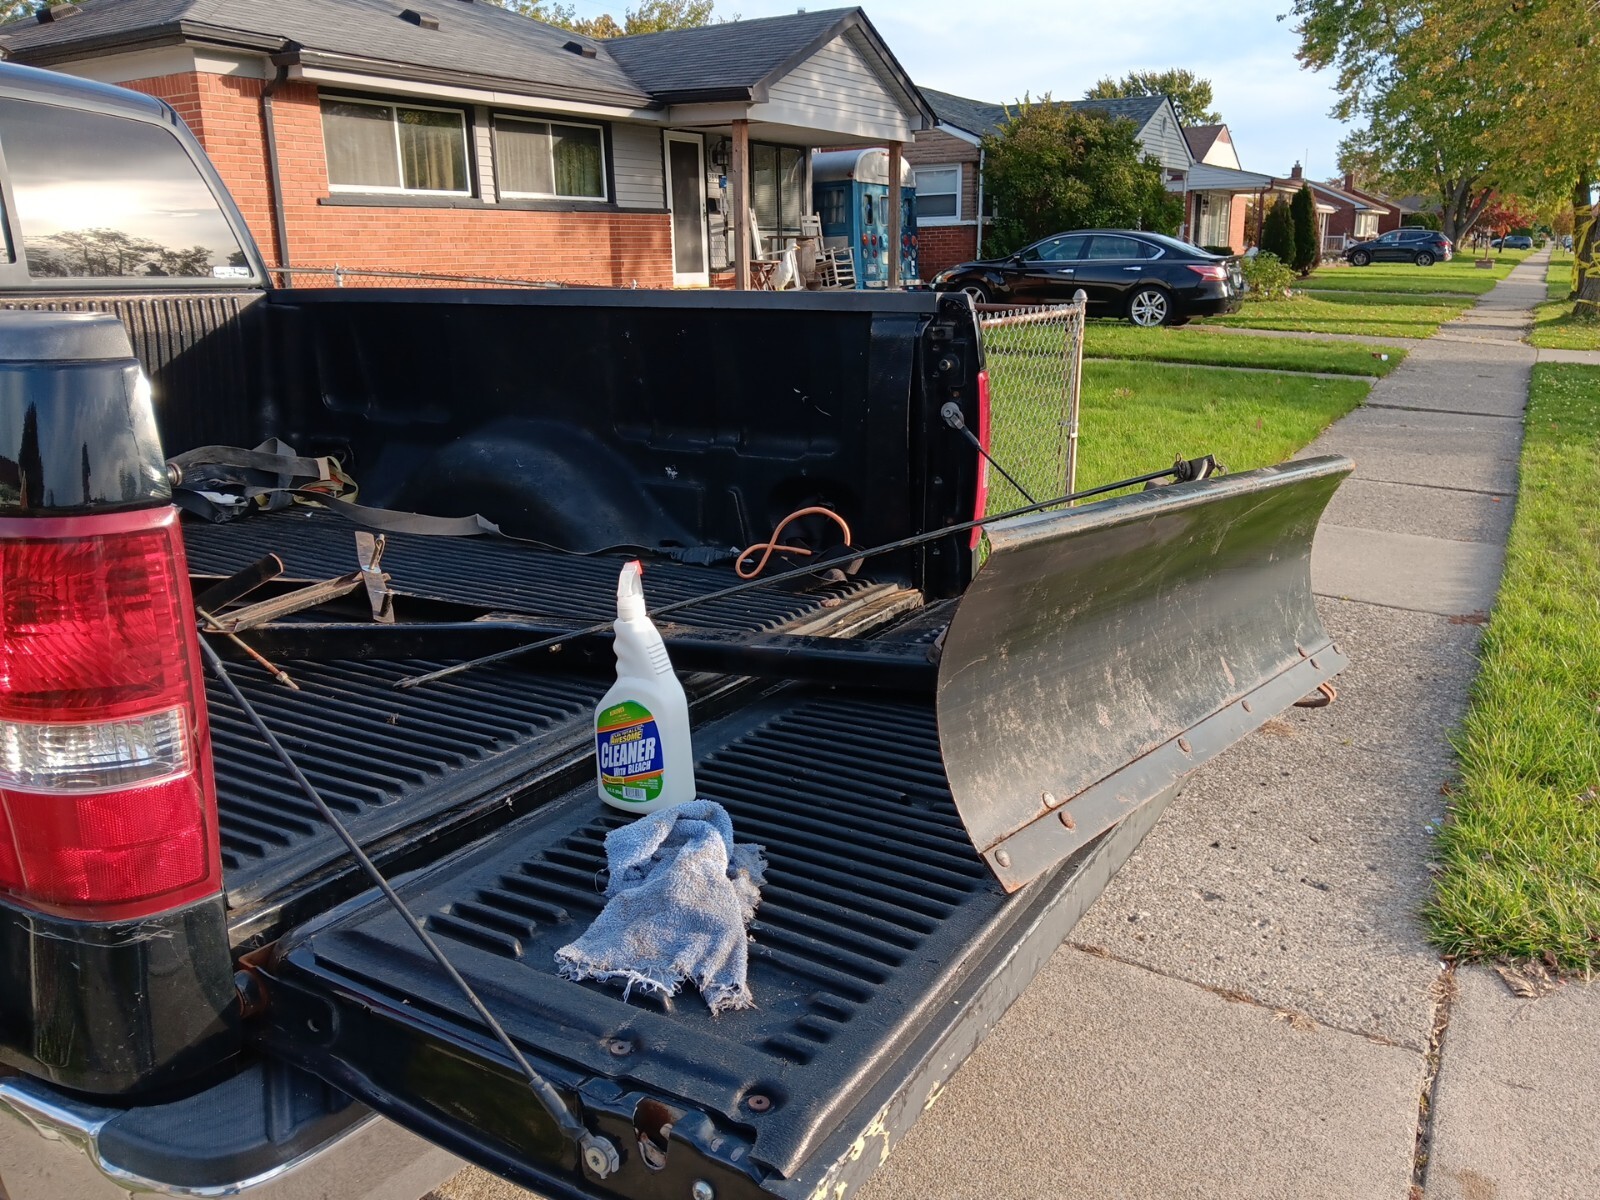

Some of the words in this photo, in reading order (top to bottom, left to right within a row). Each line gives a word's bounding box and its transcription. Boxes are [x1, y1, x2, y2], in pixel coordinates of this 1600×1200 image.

[611, 730, 642, 745] AWESOME
[601, 737, 656, 769] CLEANER
[627, 760, 652, 775] BLEACH
